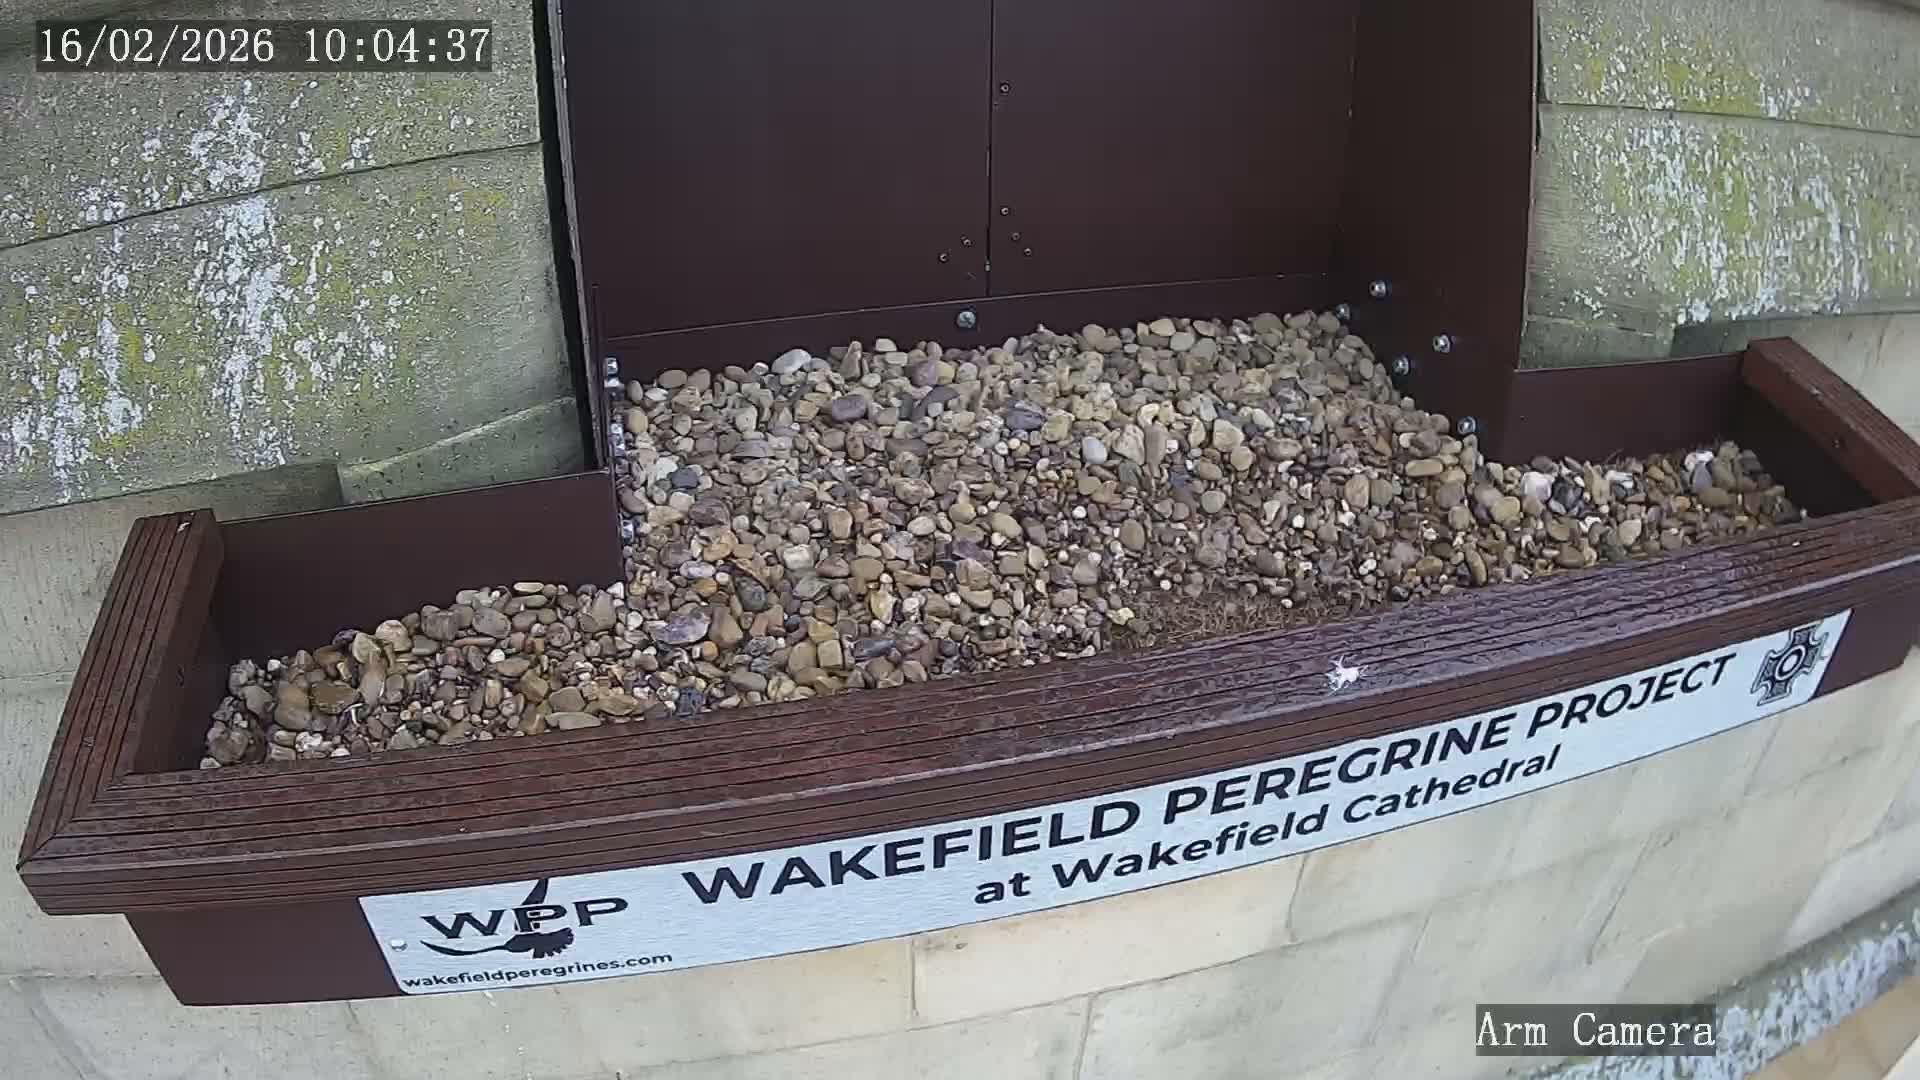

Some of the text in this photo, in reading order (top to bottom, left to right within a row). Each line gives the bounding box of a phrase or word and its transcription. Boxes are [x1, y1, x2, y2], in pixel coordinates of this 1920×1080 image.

[682, 653, 1737, 904] WAKEFIELD PEREGRINE PROJECT
[974, 745, 1561, 905] at Wakefield Cathedral
[420, 896, 629, 939] WPP
[402, 952, 673, 988] wakefieldperegrines.com
